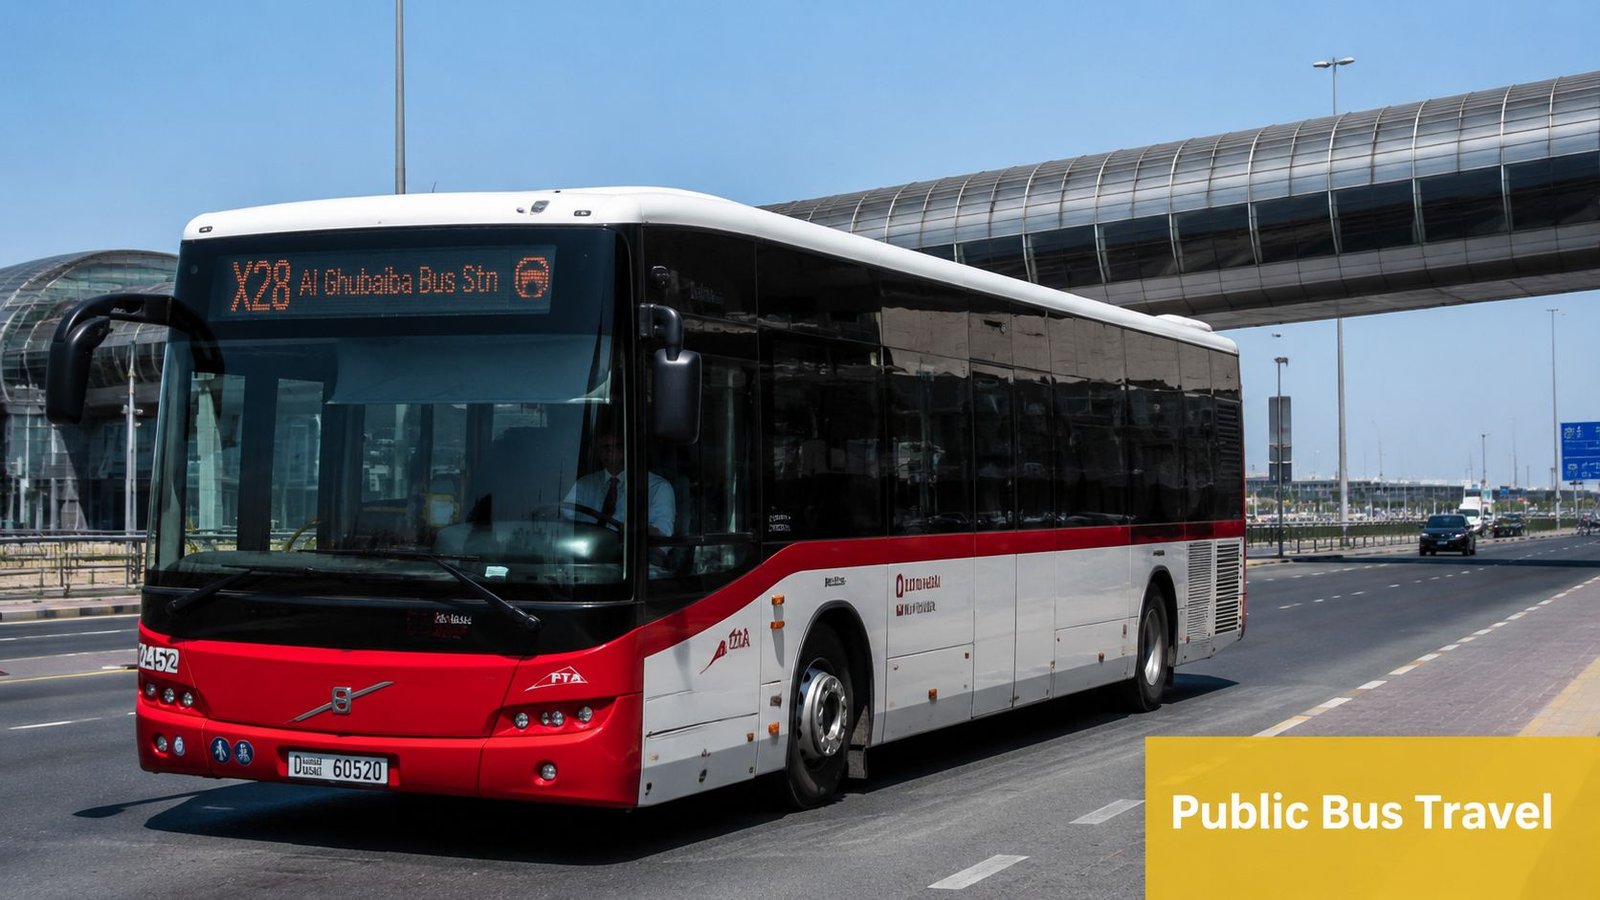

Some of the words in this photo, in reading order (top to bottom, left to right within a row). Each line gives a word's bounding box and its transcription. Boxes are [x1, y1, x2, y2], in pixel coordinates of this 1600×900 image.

[231, 259, 291, 312] X28
[299, 268, 318, 296] Al
[325, 266, 412, 296] Ghubaiba
[419, 265, 456, 294] Bus
[462, 263, 498, 293] Stn
[333, 759, 382, 781] 60520
